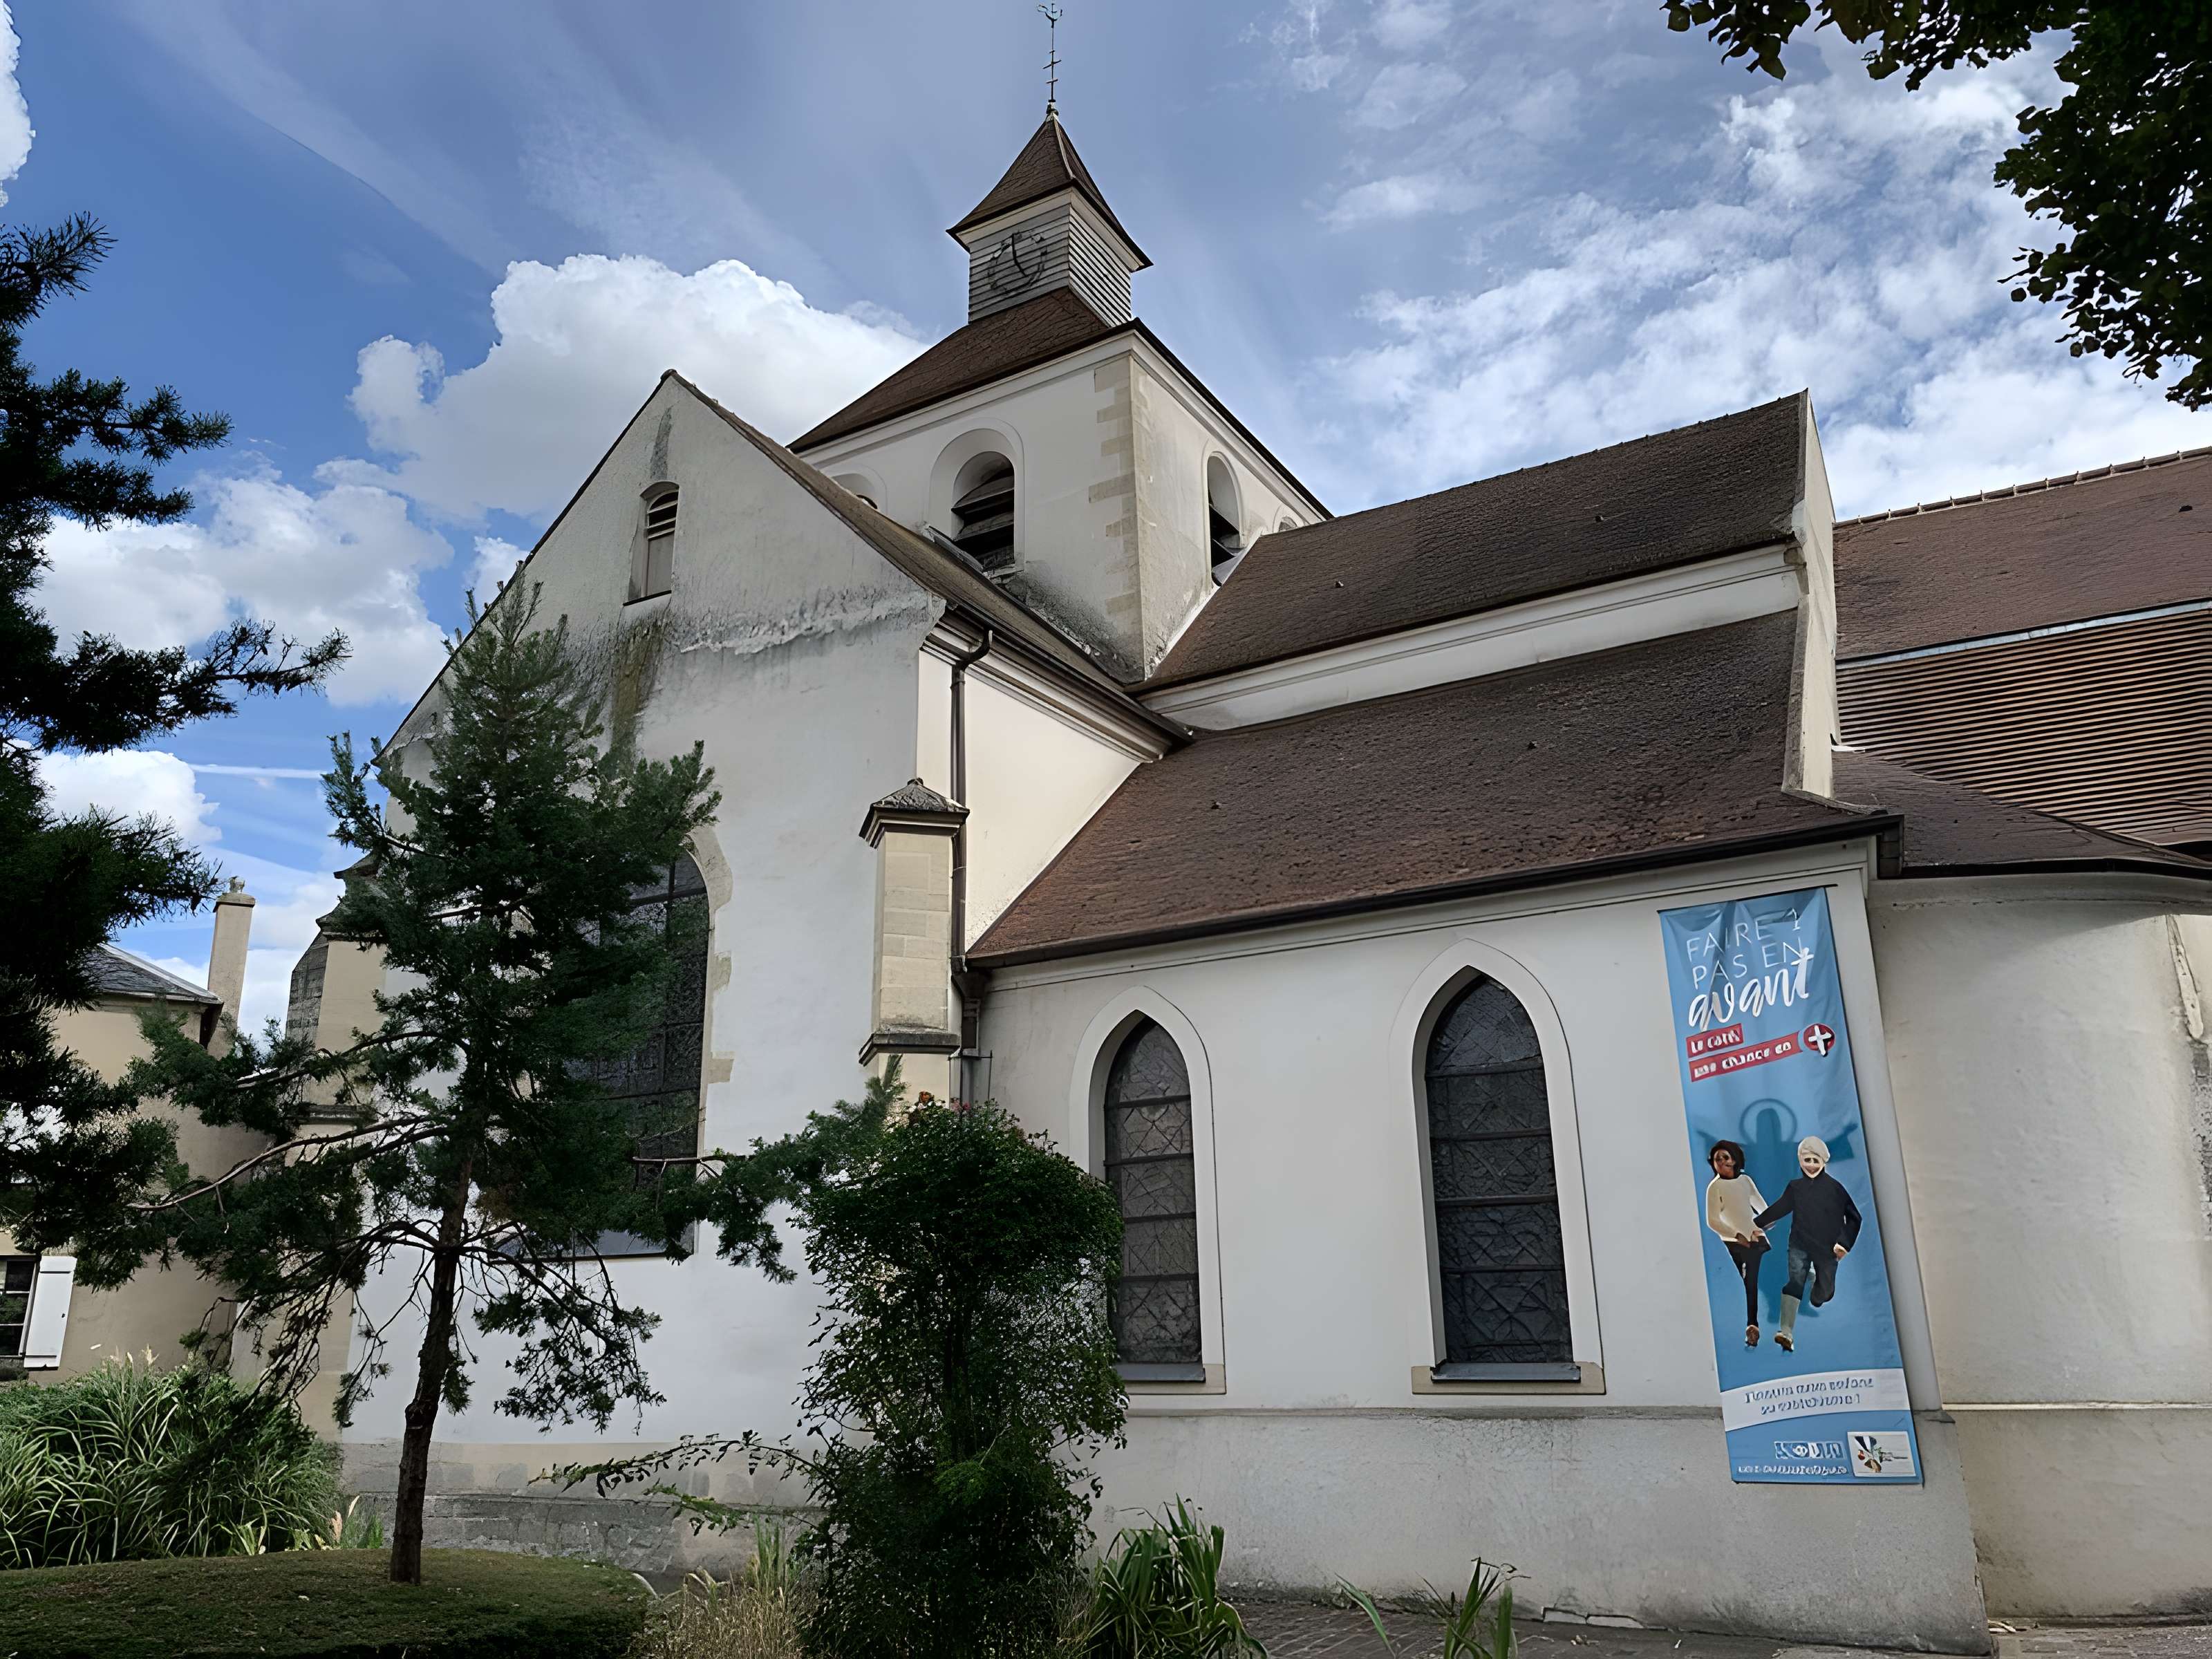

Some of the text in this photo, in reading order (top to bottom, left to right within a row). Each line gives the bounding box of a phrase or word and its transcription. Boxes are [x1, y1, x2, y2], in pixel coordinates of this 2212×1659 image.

[1686, 915, 1777, 962] FAIRE
[1692, 936, 1806, 990] PAS EN
[1688, 947, 1815, 1032] avant
